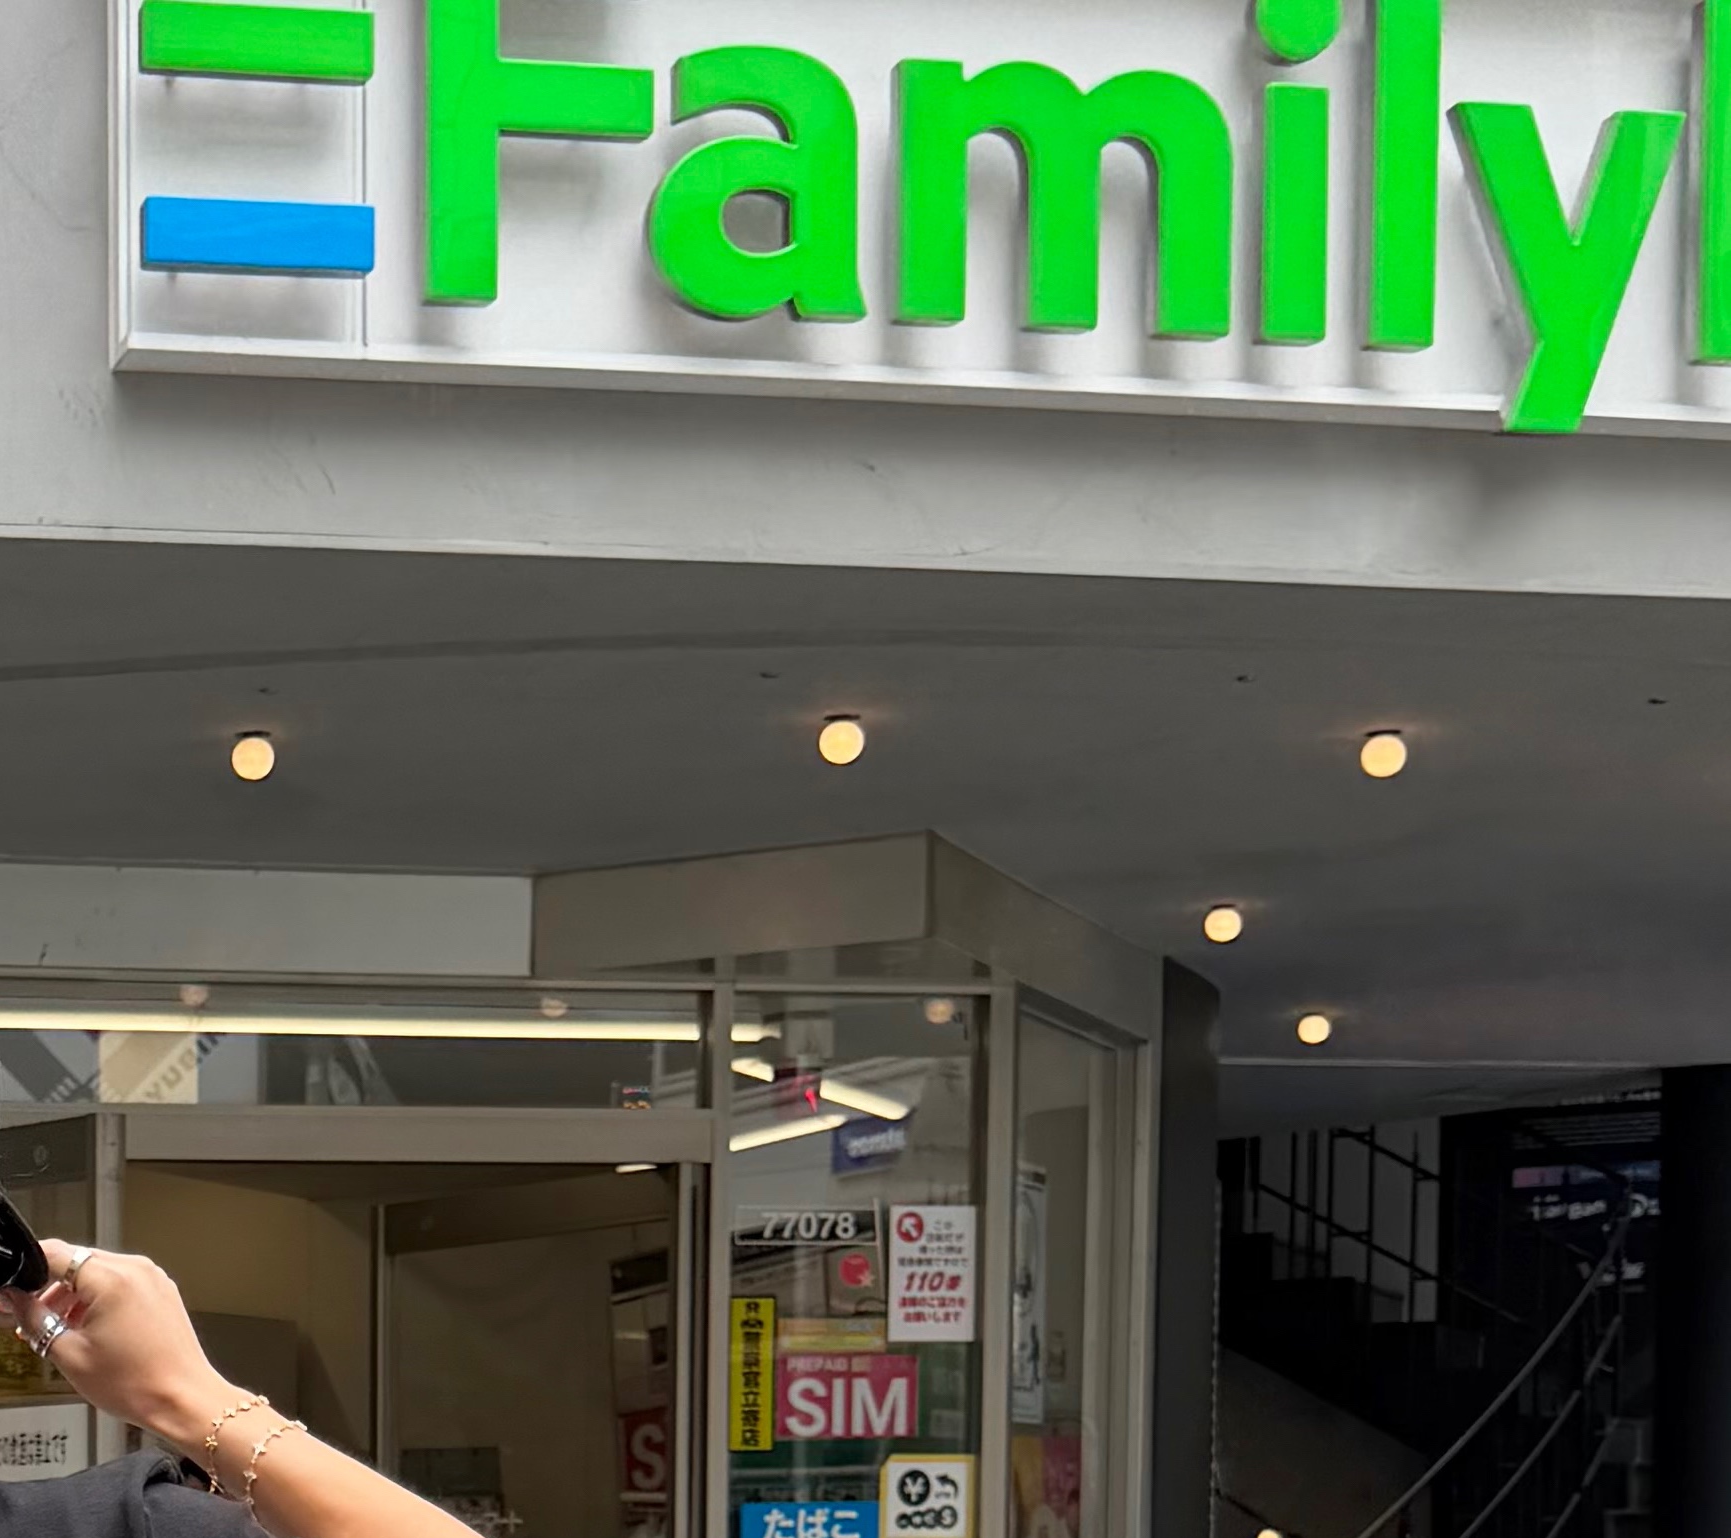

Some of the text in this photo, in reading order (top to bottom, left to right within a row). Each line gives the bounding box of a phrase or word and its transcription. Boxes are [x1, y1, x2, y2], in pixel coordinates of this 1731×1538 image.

[423, 0, 1731, 432] Family
[760, 1211, 857, 1239] 77078
[785, 1376, 910, 1438] SIM
